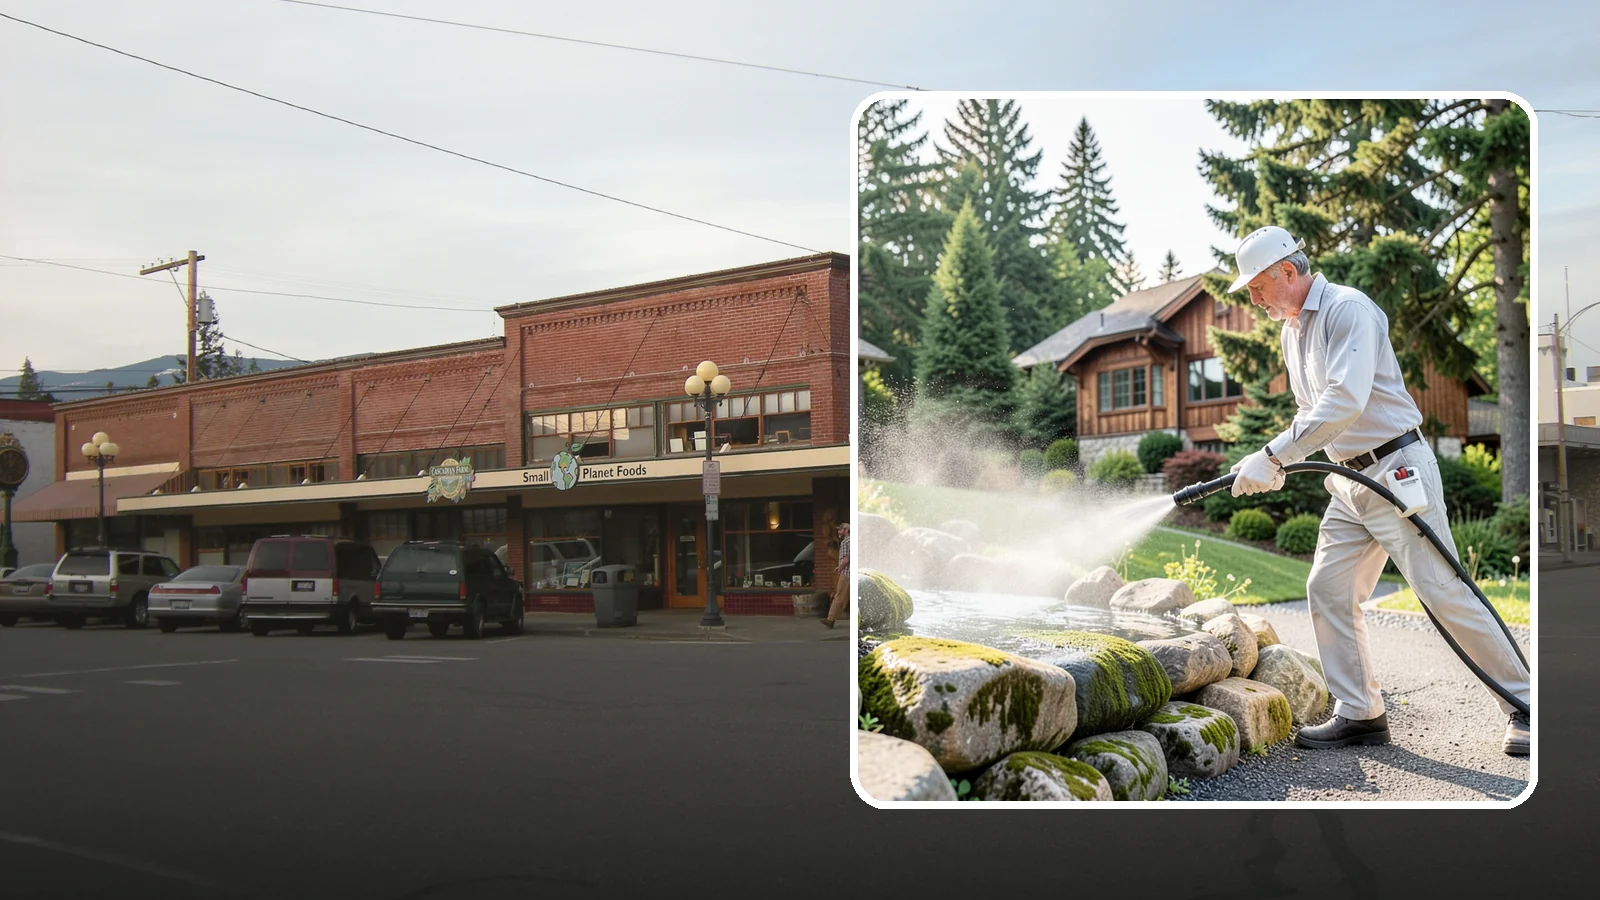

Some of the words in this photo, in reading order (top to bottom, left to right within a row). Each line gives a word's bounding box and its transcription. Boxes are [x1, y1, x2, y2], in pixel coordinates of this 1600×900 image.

[523, 471, 549, 483] Small
[582, 467, 614, 479] Planet
[616, 464, 647, 477] Foods
